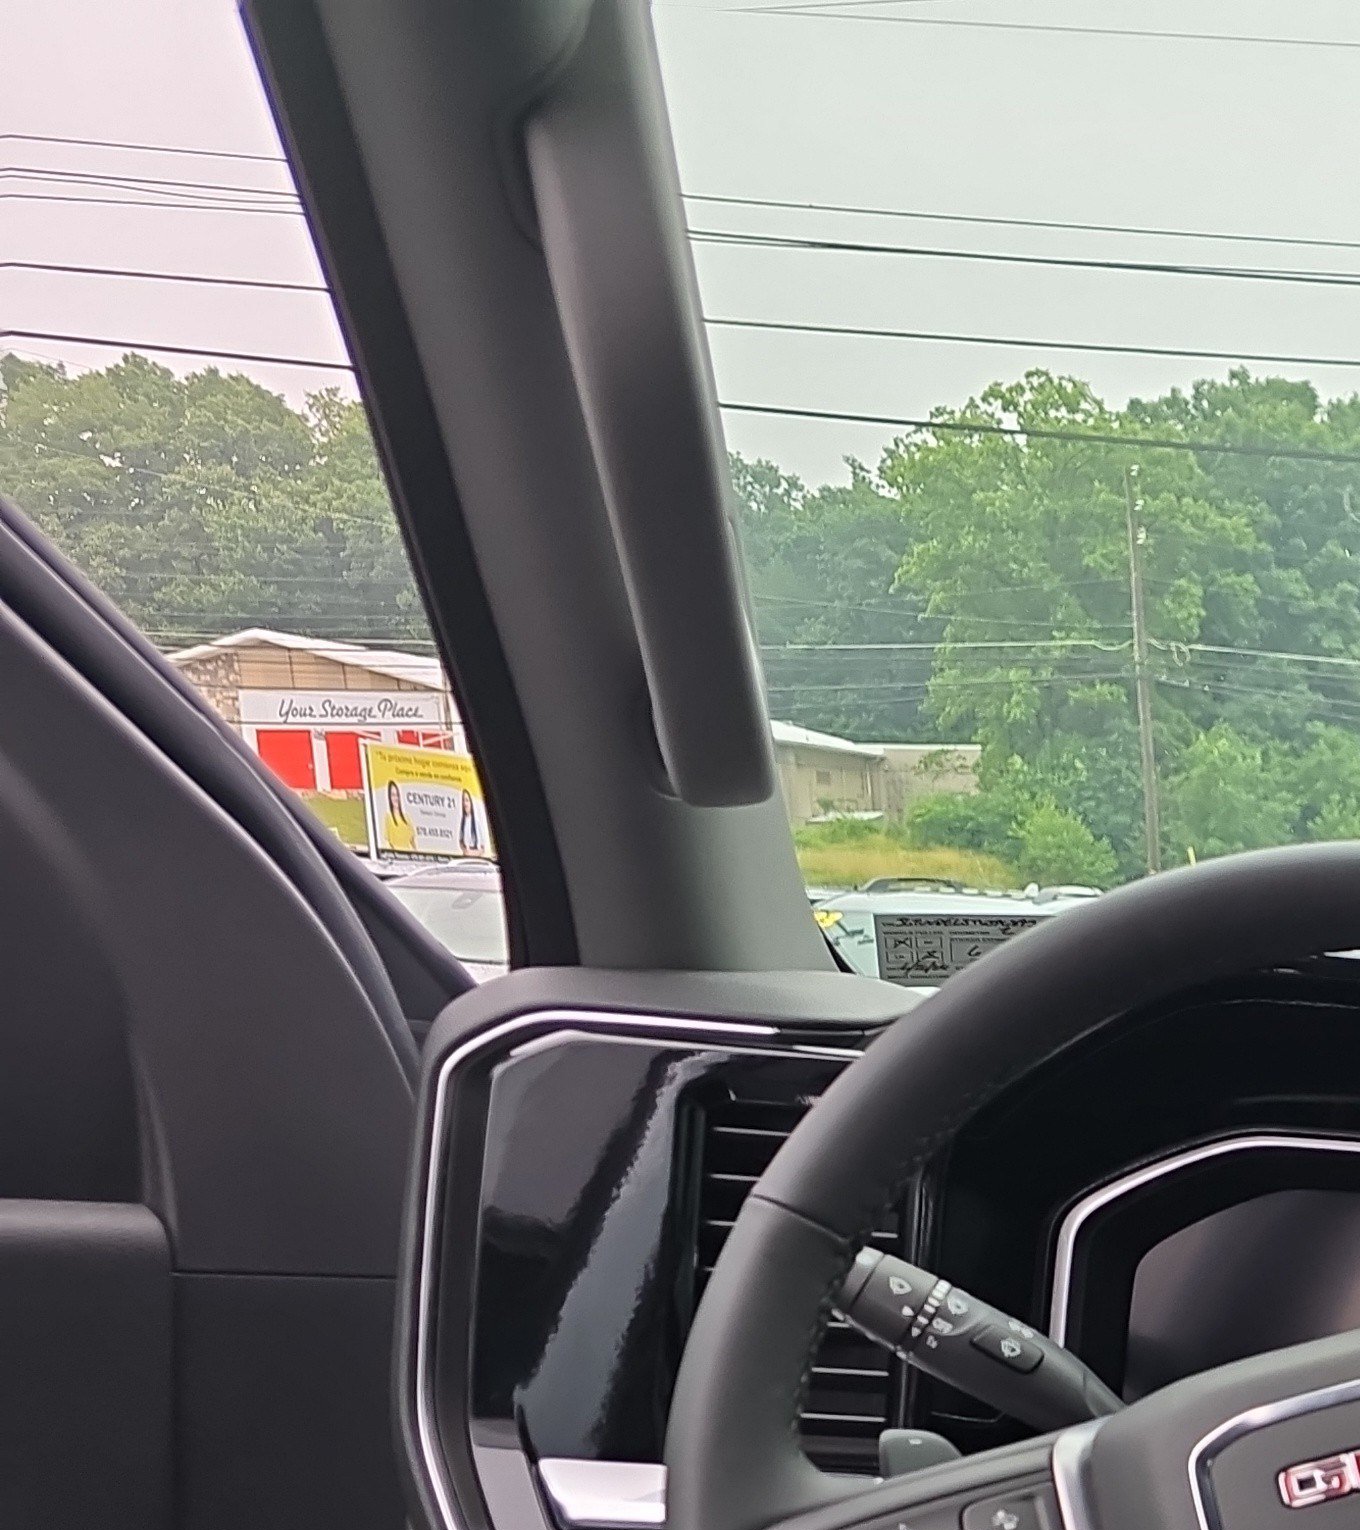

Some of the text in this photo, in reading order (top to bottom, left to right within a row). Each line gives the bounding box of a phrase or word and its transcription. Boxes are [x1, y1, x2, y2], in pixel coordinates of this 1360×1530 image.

[279, 698, 423, 723] Your Storage Place
[406, 792, 456, 809] CENTURY 21
